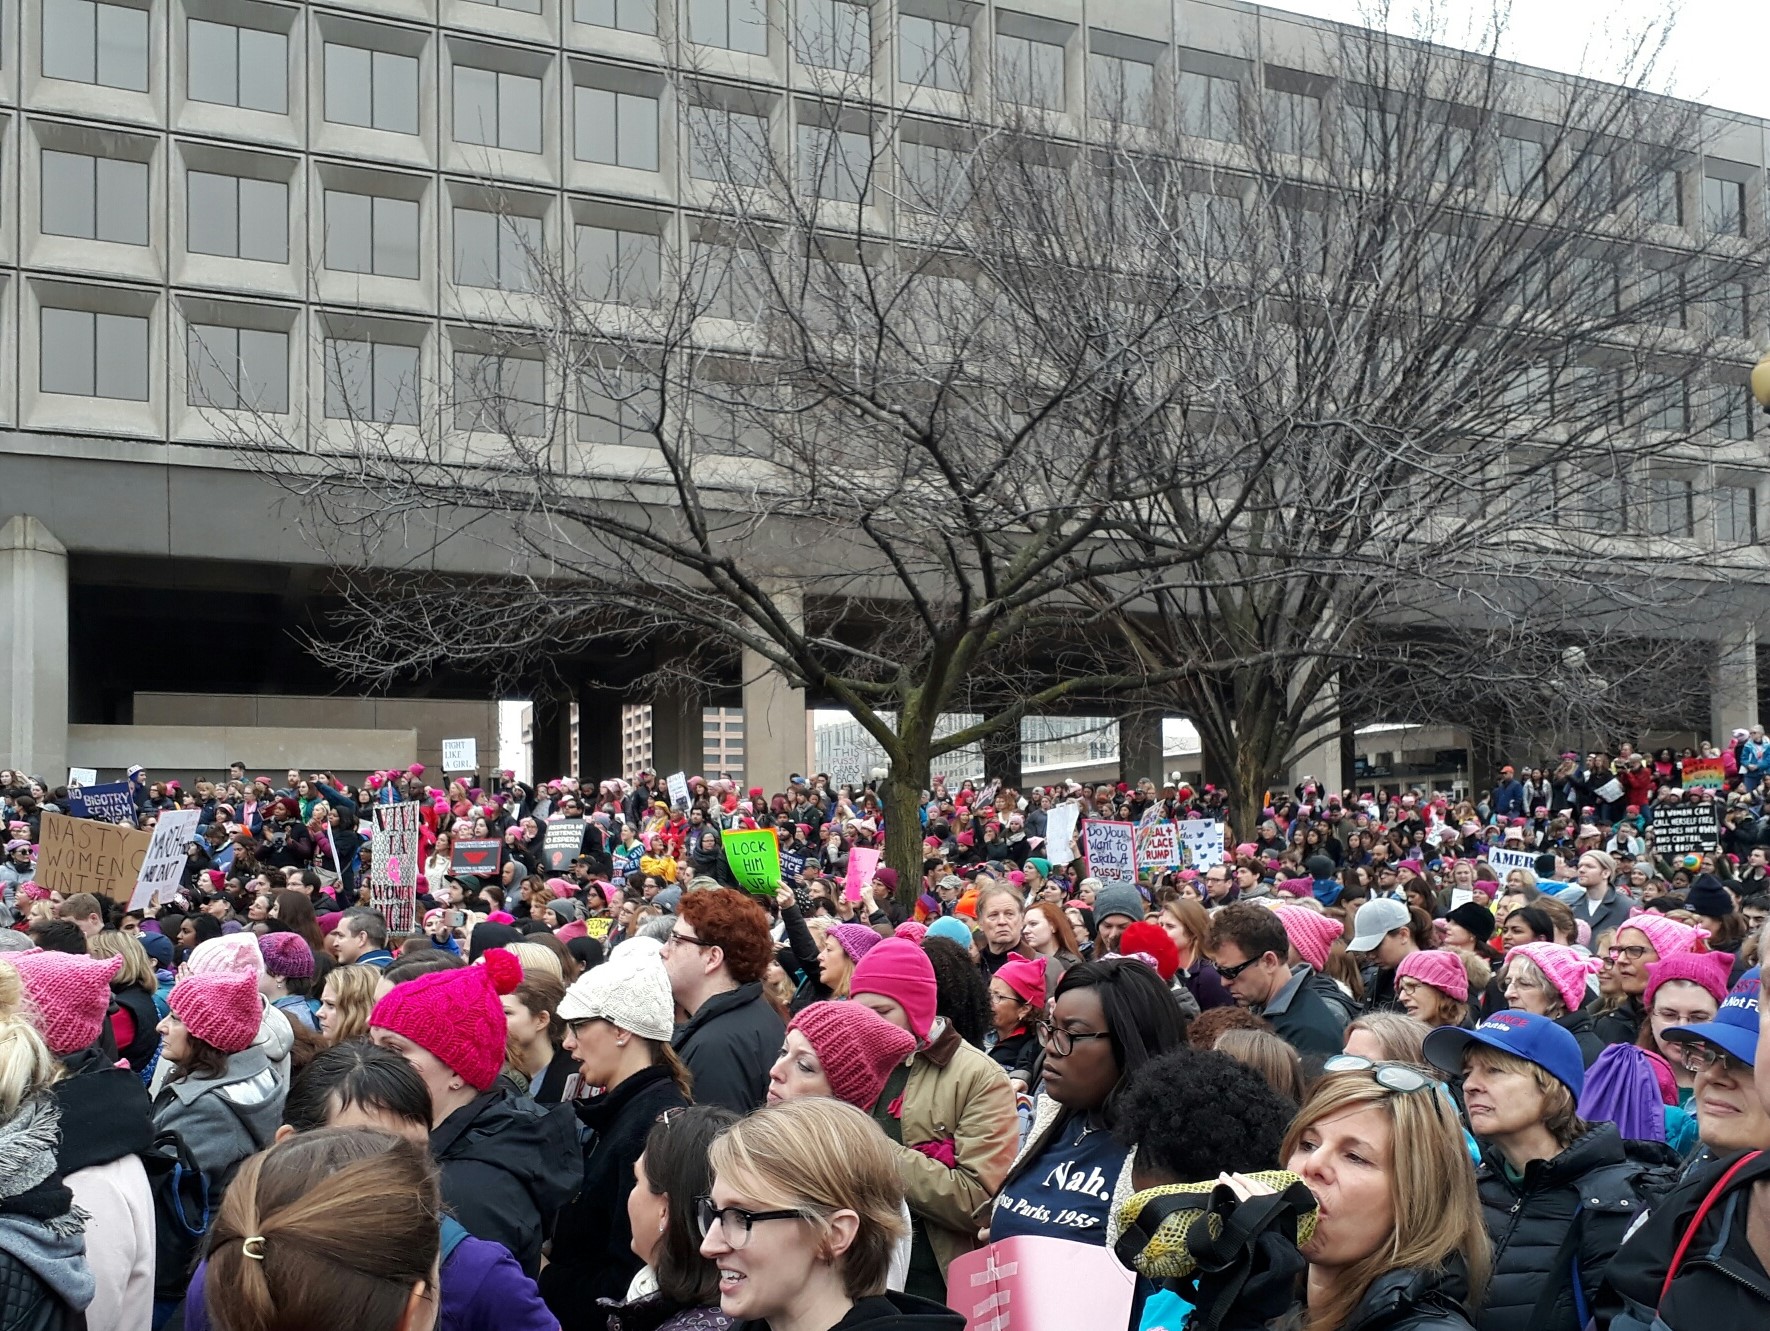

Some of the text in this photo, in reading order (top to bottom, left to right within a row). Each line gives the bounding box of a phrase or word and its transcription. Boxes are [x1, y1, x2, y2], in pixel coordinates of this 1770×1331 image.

[445, 751, 461, 759] LIKE
[833, 749, 860, 757] THIS
[836, 774, 858, 783] BACK
[67, 788, 82, 800] NO
[83, 792, 129, 807] BIGOTRY
[87, 804, 132, 817] SEXISM
[1654, 807, 1710, 818] NO WOMAN CAN
[1653, 816, 1714, 827] CALL HERSELF FREE
[1087, 826, 1124, 840] Do You
[1699, 825, 1717, 833] OWN
[48, 817, 130, 856] NASTY
[1672, 835, 1702, 843] CONTROL
[732, 841, 767, 856] LOCK
[1088, 839, 1128, 851] Want to
[46, 847, 125, 878] WOMEN
[743, 858, 765, 872] HIM
[1120, 853, 1129, 864] A
[1491, 851, 1535, 868] AMER
[1091, 866, 1120, 880] Pussy
[45, 871, 116, 896] UNITE
[1042, 1161, 1109, 1201] Nah.
[1012, 1198, 1051, 1223] Parks,
[1053, 1209, 1100, 1228] 1955
